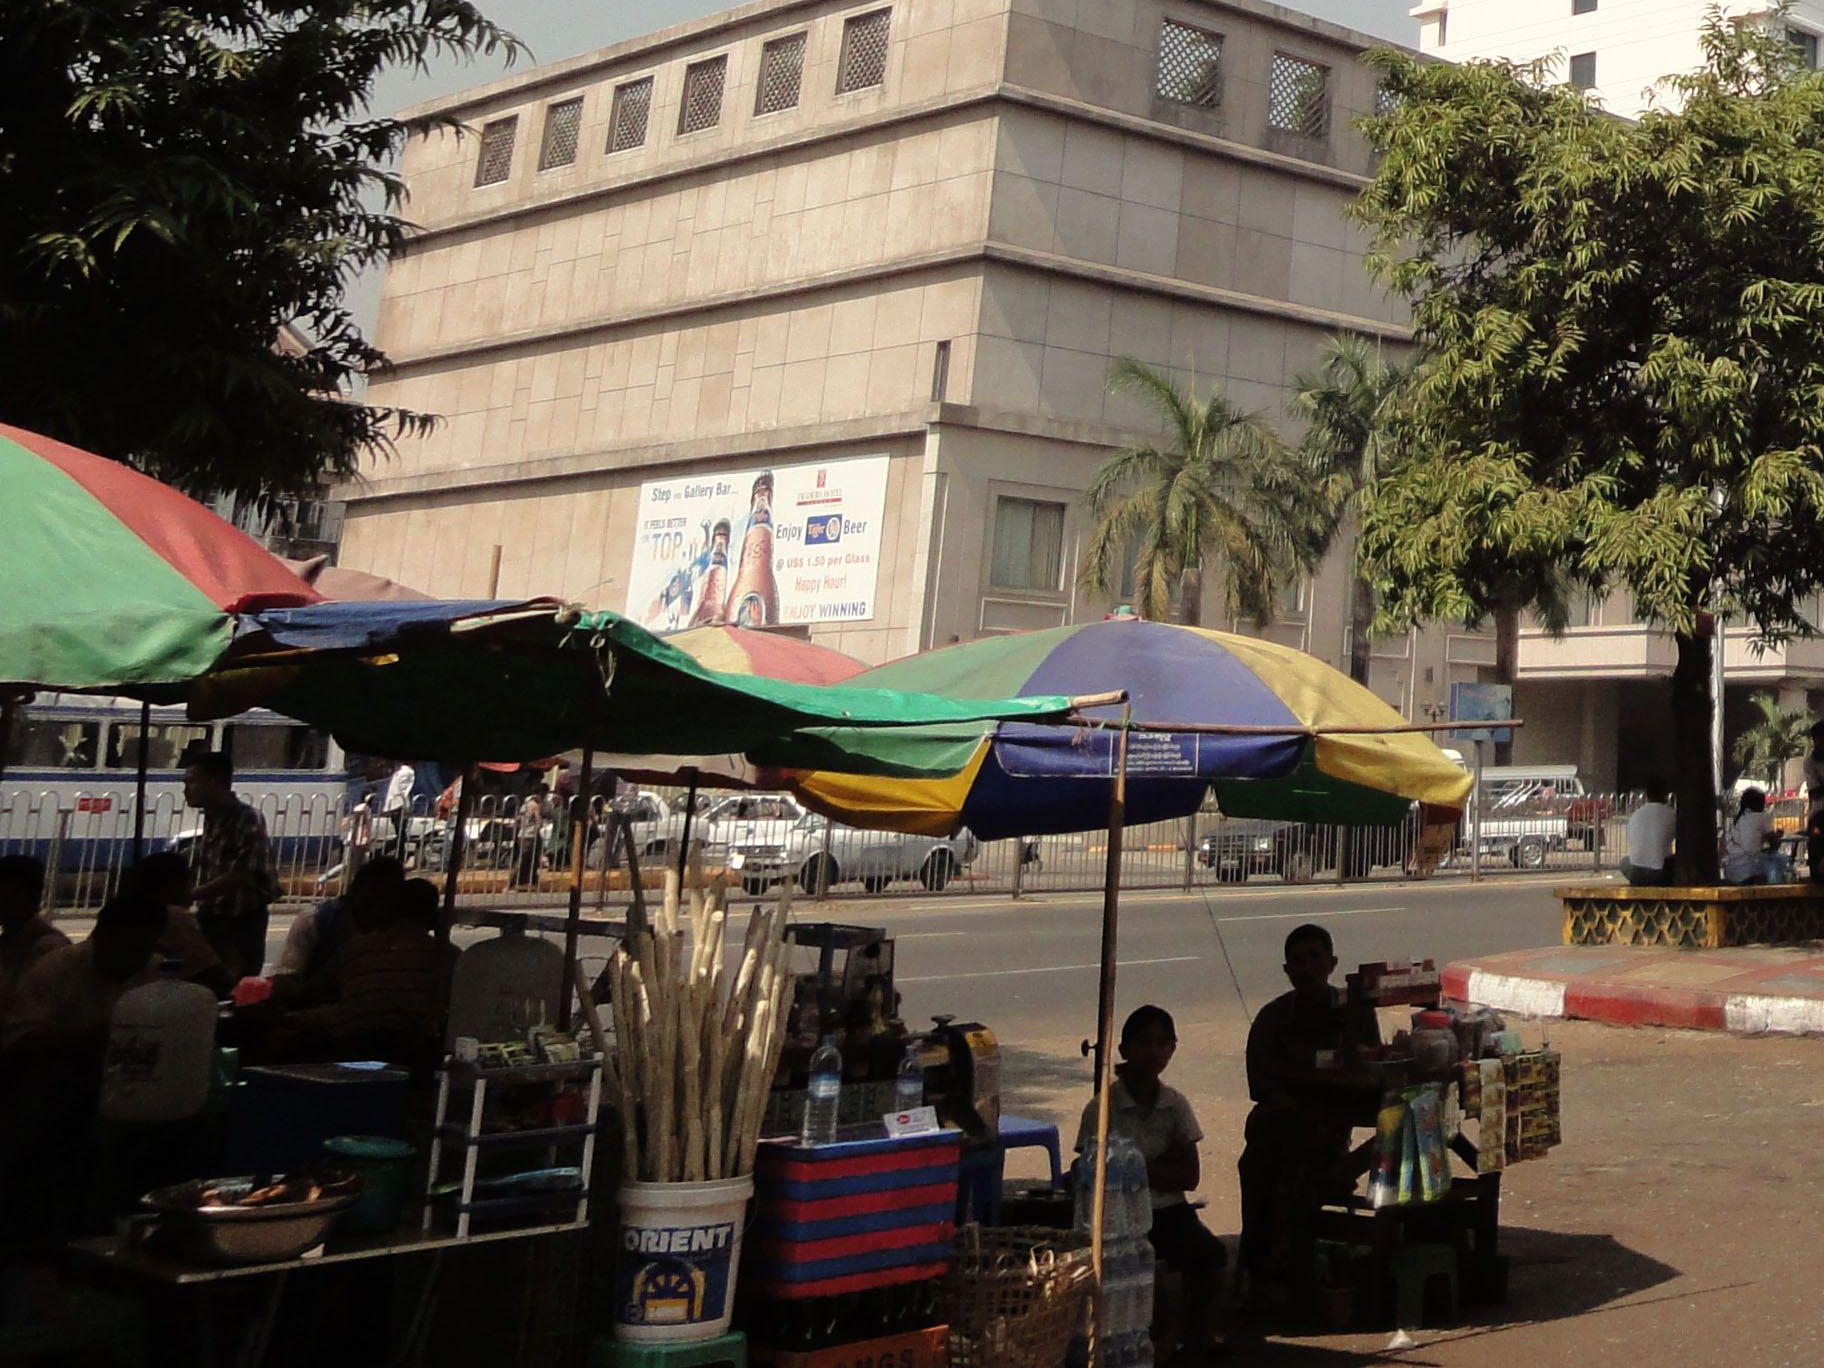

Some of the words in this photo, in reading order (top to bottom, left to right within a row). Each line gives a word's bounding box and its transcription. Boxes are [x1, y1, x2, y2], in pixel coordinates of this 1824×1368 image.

[651, 488, 672, 504] Step
[684, 484, 714, 500] Gallery
[776, 523, 803, 542] Enjoy
[843, 519, 867, 535] Beer
[807, 555, 826, 567] 1.50
[828, 556, 842, 568] per
[845, 553, 871, 565] Glass
[795, 576, 821, 594] Happy
[783, 604, 816, 619] ENJOY
[819, 601, 866, 619] WINNING
